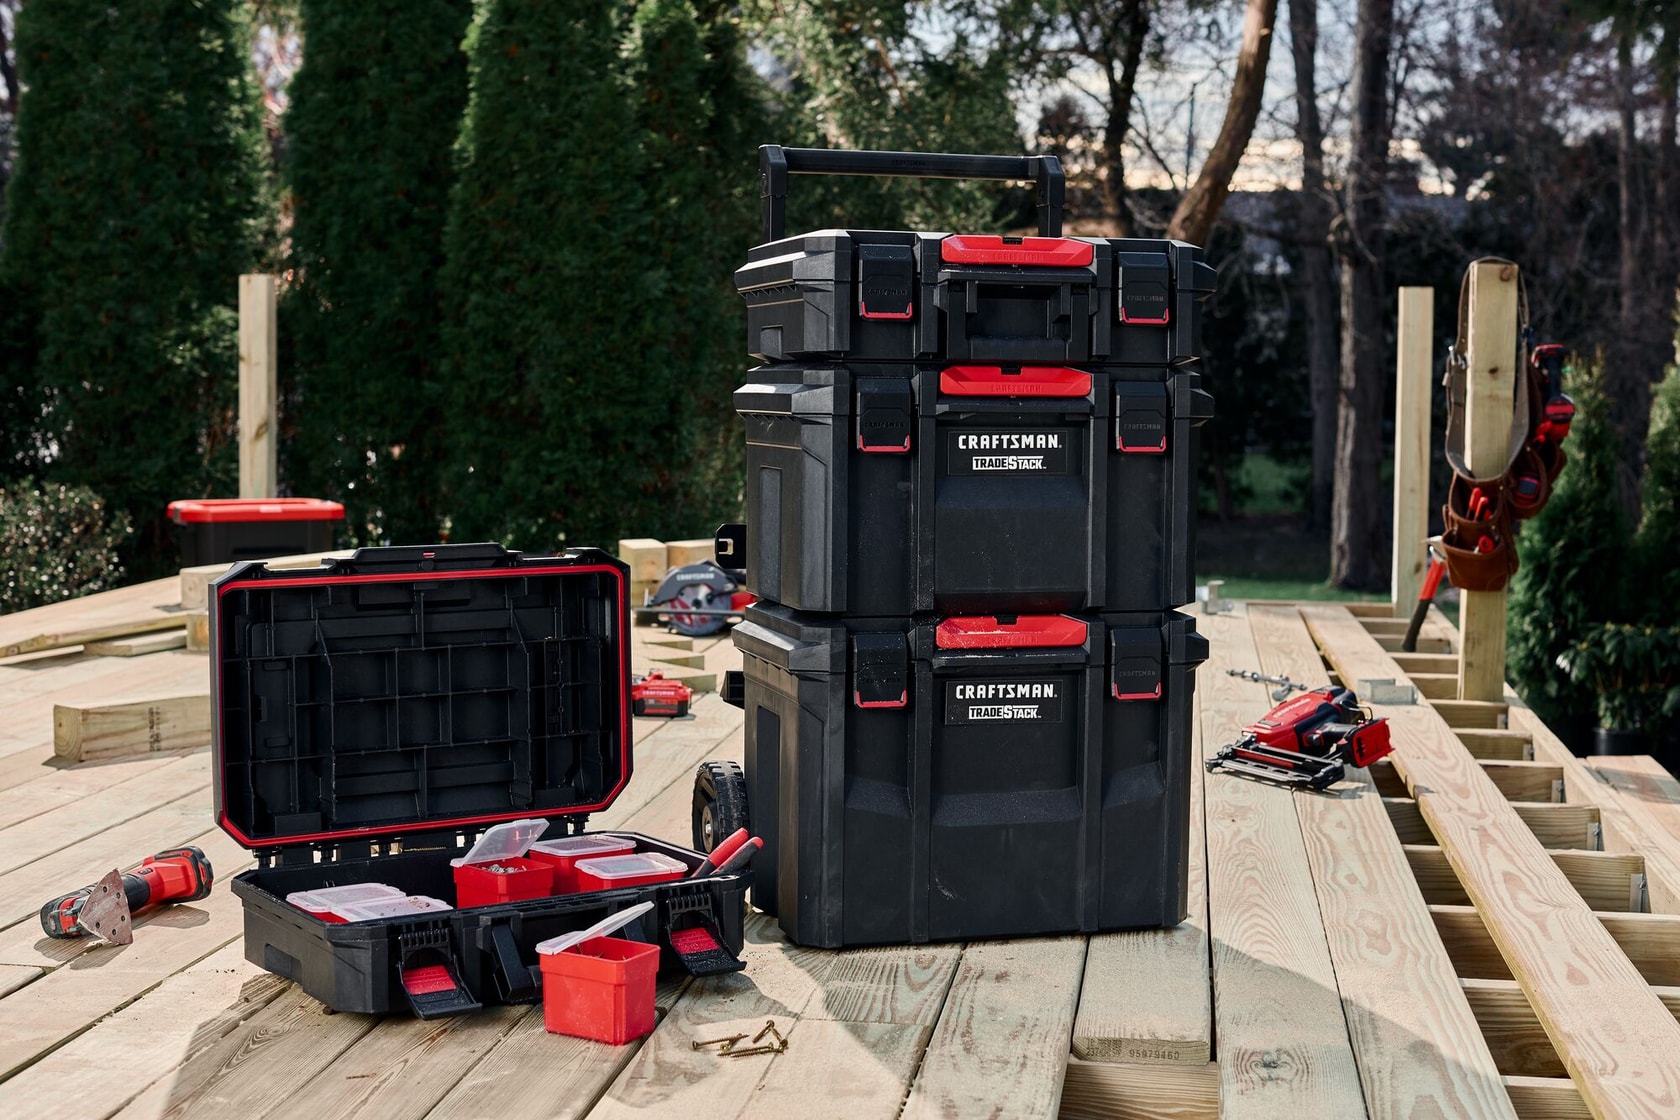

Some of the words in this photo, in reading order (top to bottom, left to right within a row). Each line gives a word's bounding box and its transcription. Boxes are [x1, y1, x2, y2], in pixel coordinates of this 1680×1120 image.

[957, 434, 1059, 449] CRAFTSMAN
[972, 455, 1044, 471] TRADESTACK
[955, 684, 1055, 700] CRAFTSMAN
[968, 705, 1039, 720] TRADESTACK
